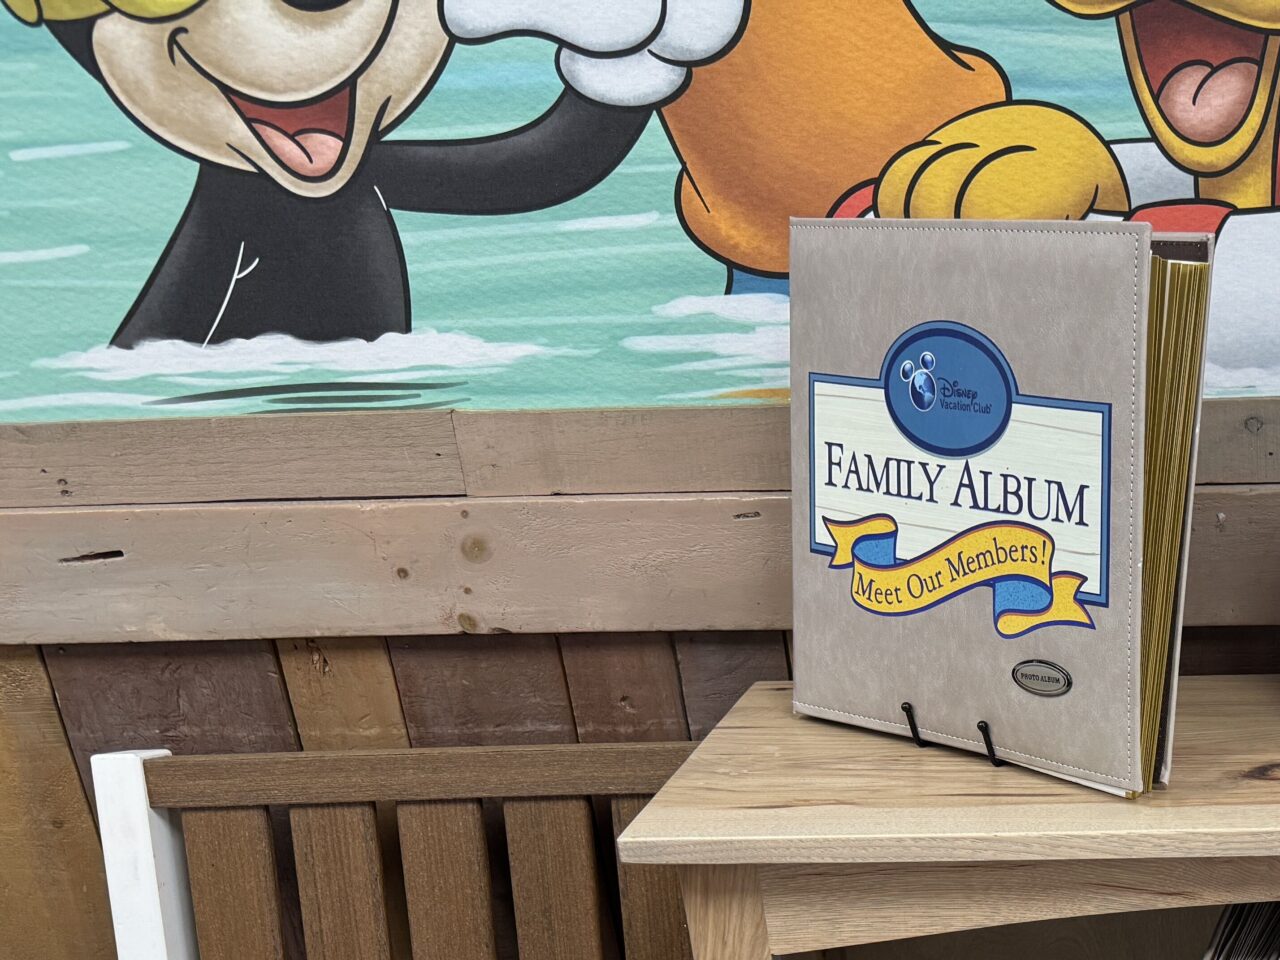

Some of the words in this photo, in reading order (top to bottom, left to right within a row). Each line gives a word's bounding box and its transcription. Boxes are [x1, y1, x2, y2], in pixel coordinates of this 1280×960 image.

[940, 399, 971, 412] Vacation
[823, 441, 946, 504] FAMILY
[950, 459, 1090, 527] ALBUM
[854, 571, 902, 605] Meet
[906, 569, 944, 599] Our
[945, 537, 1047, 583] Members!
[1020, 672, 1040, 682] PHOTO
[1040, 675, 1061, 684] ALBUM
